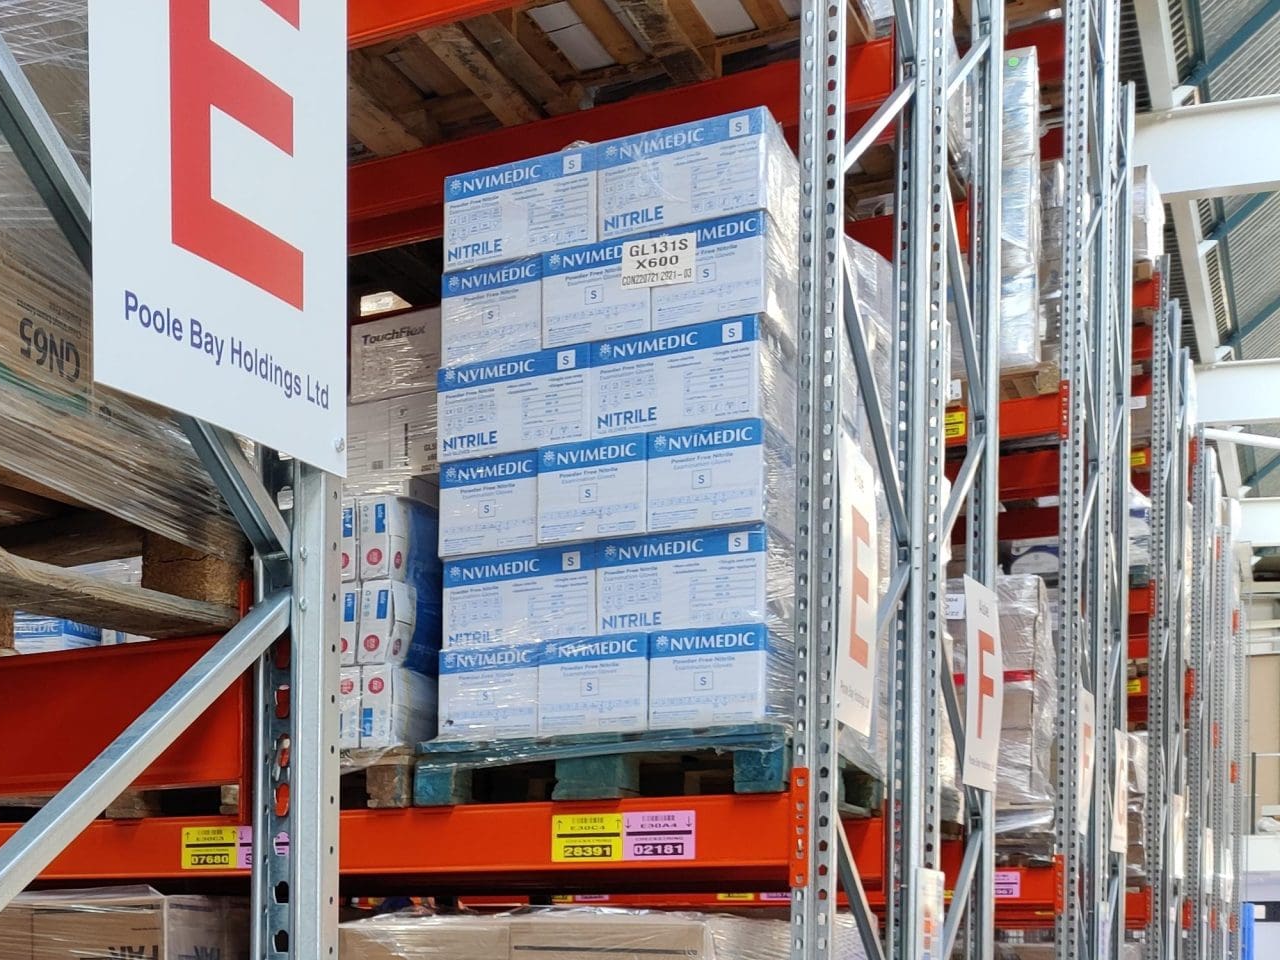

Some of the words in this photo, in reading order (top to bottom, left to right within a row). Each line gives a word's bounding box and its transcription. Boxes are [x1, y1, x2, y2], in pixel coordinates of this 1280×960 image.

[735, 122, 742, 132] S
[620, 128, 705, 159] NVIMEDIC
[169, 0, 304, 312] E
[568, 159, 575, 169] S
[463, 165, 542, 192] NVIMEDIC
[604, 206, 664, 232] NITRILE
[447, 239, 503, 262] NITRILE
[629, 239, 688, 258] GL131S
[636, 255, 679, 269] X600
[461, 264, 536, 290] NVIMEDIC
[362, 325, 426, 345] TouchFlex
[728, 328, 735, 338] S
[20, 318, 80, 383] GN65
[124, 290, 183, 341] Poole
[190, 318, 224, 365] Bay
[231, 337, 302, 398] Holdings
[307, 375, 329, 410] Ltd
[613, 332, 698, 358] NVIMEDIC
[457, 359, 535, 383] NVIMEDIC
[597, 406, 657, 430] NITRILE
[669, 427, 753, 450] NVIMEDIC
[557, 443, 637, 465] NVIMEDIC
[584, 488, 591, 498] S
[619, 539, 703, 560] NVIMEDIC
[734, 537, 741, 547] S
[462, 558, 540, 581] NVIMEDIC
[851, 505, 870, 668] E
[602, 611, 662, 629] NITRILE
[670, 632, 755, 651] NVIMEDIC
[978, 629, 995, 738] F
[192, 855, 229, 864] 07680
[564, 846, 611, 856] 28391
[634, 844, 683, 855] 02181
